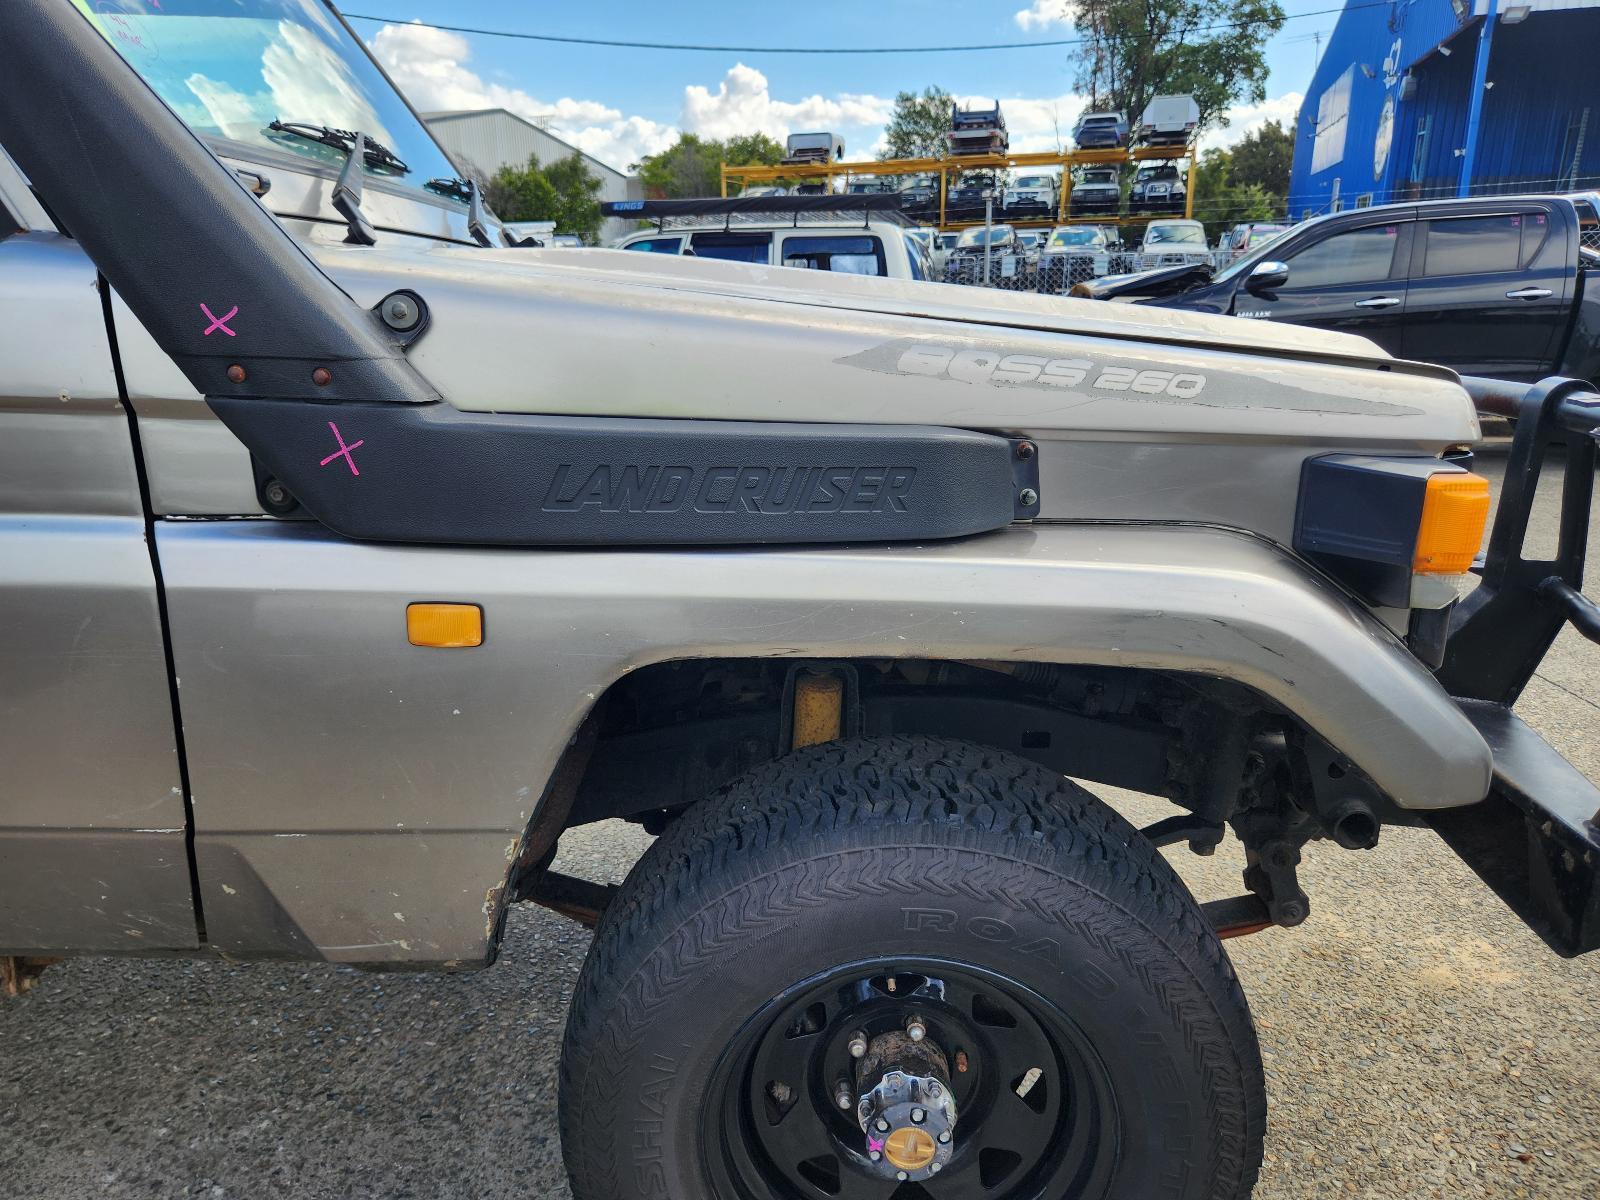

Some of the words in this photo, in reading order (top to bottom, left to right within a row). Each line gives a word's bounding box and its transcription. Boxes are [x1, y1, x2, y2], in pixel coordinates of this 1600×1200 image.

[897, 344, 1094, 387] BOSS
[1092, 365, 1208, 399] 260
[900, 906, 1120, 1000] ROAD
